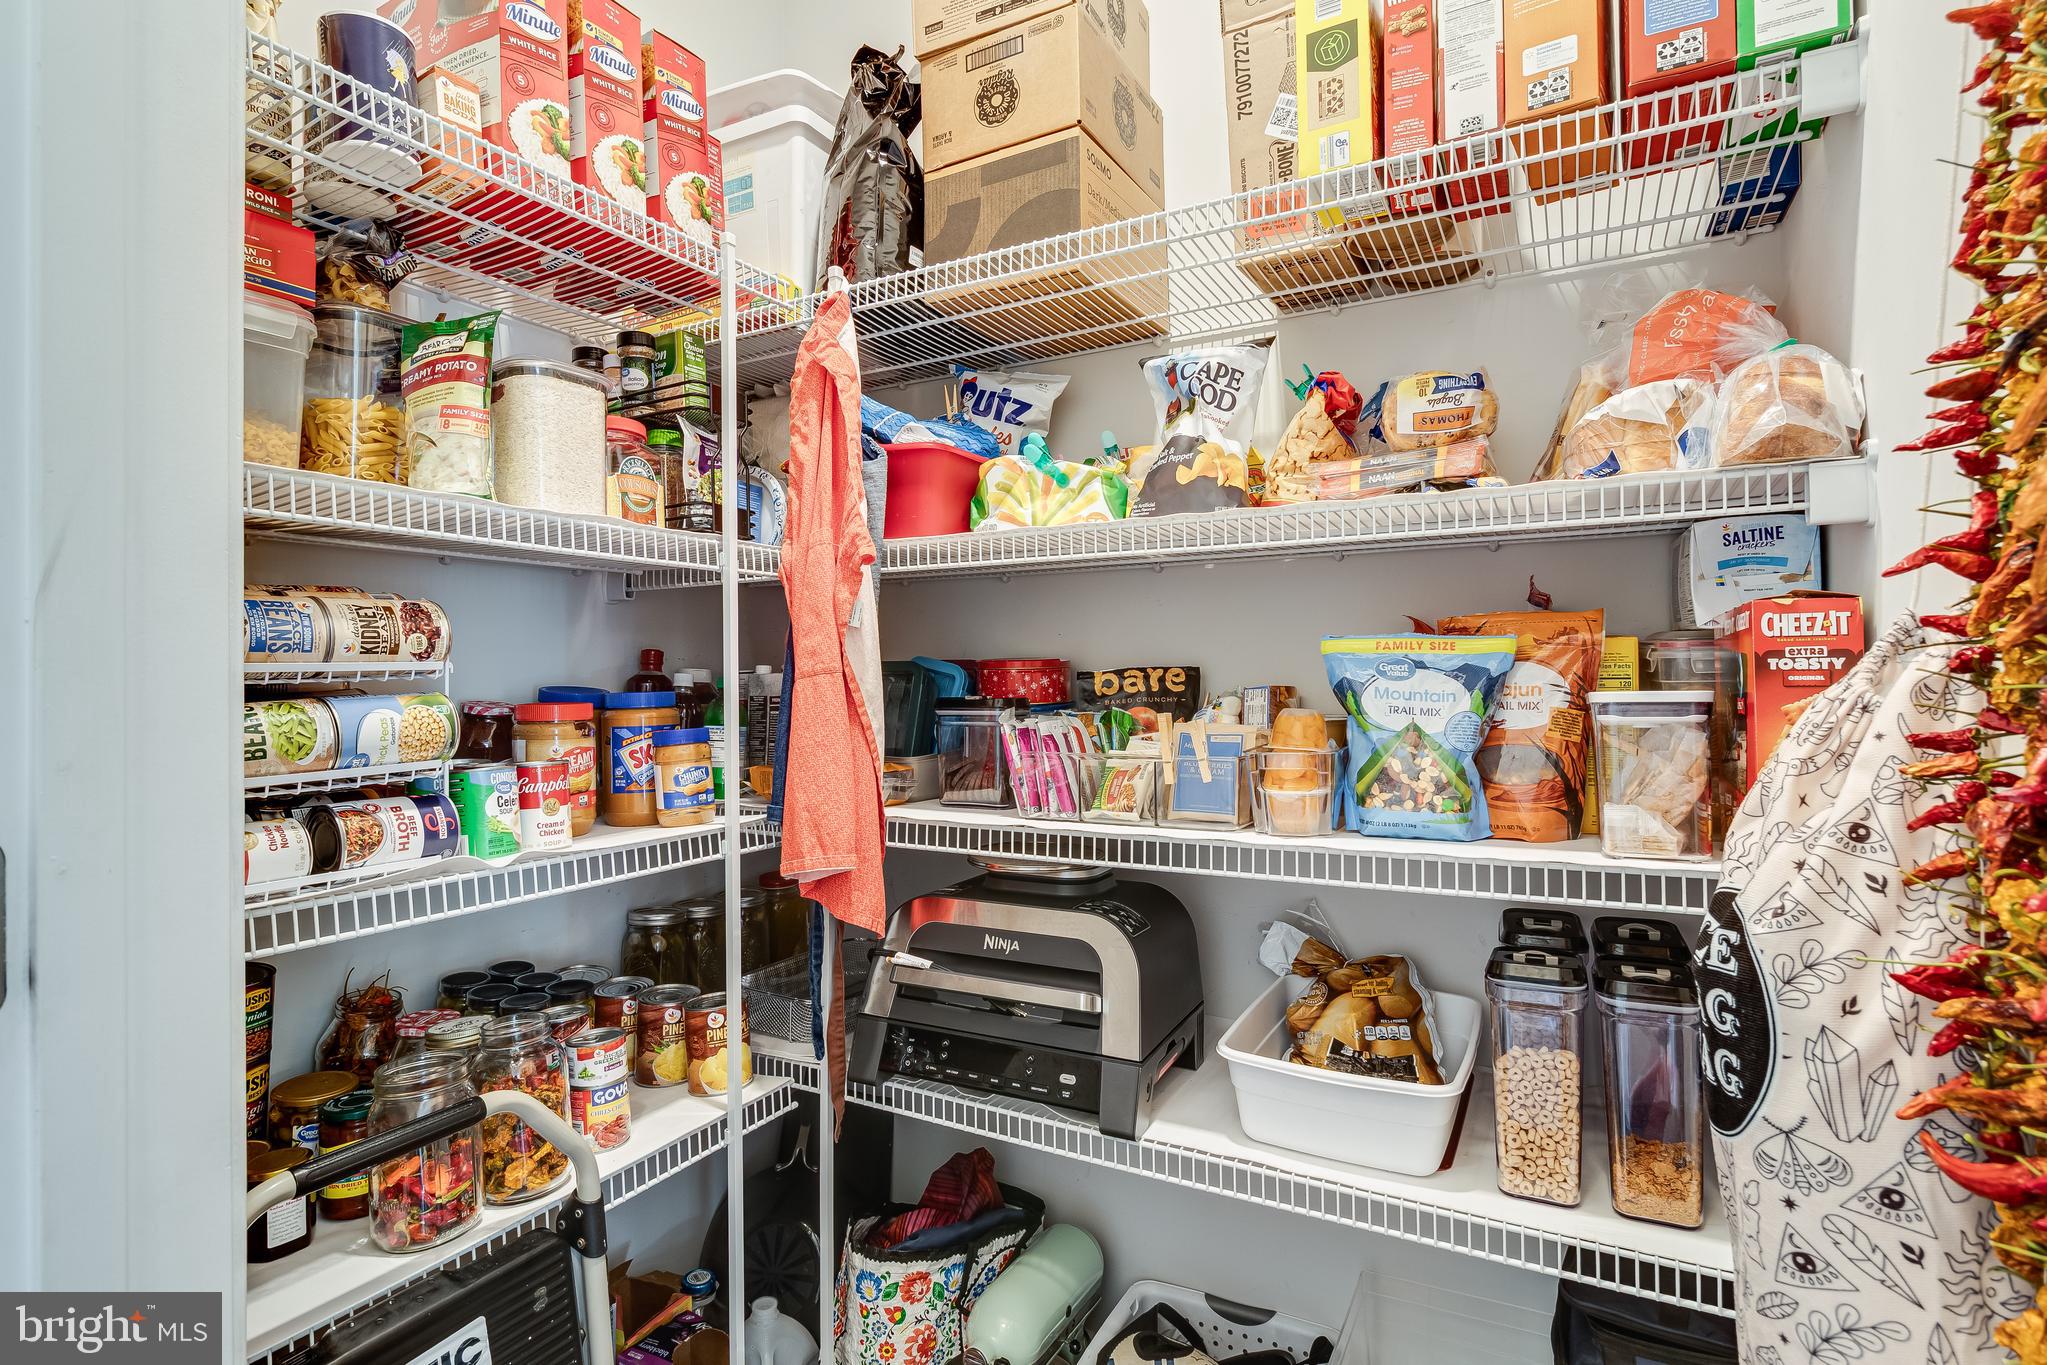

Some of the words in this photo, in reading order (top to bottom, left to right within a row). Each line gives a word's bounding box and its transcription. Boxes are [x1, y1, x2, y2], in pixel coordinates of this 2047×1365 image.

[506, 3, 562, 39] Minute
[508, 35, 537, 54] WHITE
[538, 46, 558, 63] RICE
[590, 46, 637, 79] Minute
[517, 74, 527, 87] 5
[978, 68, 1015, 88] Regular
[1233, 28, 1252, 121] 7910077272
[591, 75, 617, 93] WHITE
[617, 86, 634, 101] RICE
[443, 94, 477, 117] BAKING
[443, 104, 477, 124] SODA
[661, 90, 705, 118] Minute
[599, 111, 607, 123] 5
[663, 118, 688, 134] WHITE
[688, 126, 702, 140] RICE
[669, 150, 678, 163] 5
[683, 341, 704, 354] Onion
[434, 359, 478, 374] POTATO
[1181, 359, 1245, 392] CAPE
[1188, 376, 1237, 414] COD
[1425, 392, 1465, 408] Bagels
[442, 407, 470, 417] FAMILY
[442, 418, 451, 430] 8
[1168, 452, 1194, 464] Pepper
[1369, 454, 1397, 466] NAAN
[1368, 472, 1396, 484] NAAN
[1722, 525, 1785, 547] SALTINE
[1737, 539, 1776, 551] crackers
[260, 601, 290, 653] BEANS
[285, 601, 302, 653] BLACK
[301, 613, 312, 627] LOW
[348, 616, 360, 638] dark
[352, 604, 381, 655] KIDNEY
[373, 605, 389, 655] BEANS
[302, 627, 313, 651] SODIUM
[1375, 640, 1425, 651] FAMILY
[1428, 641, 1457, 651] SIZE
[1379, 662, 1409, 673] Great
[1386, 669, 1409, 677] Value
[1094, 667, 1187, 697] bare
[1502, 682, 1543, 699] ajun
[1104, 697, 1135, 706] BAKED
[1135, 695, 1179, 705] CRUNCHY
[1373, 686, 1457, 704] Mountain
[1388, 704, 1416, 716] TRAIL
[1419, 706, 1442, 717] MIX
[1517, 701, 1541, 712] MIX
[379, 718, 388, 743] Peas
[678, 767, 707, 782] CHUNKY
[499, 807, 513, 815] SOUP
[389, 805, 410, 852] BROTH
[406, 815, 418, 837] BEEF
[435, 807, 447, 838] SWANSON
[536, 821, 559, 830] Cream
[539, 828, 565, 837] Chicken
[263, 826, 278, 852] Chicken
[274, 824, 289, 849] Noodle
[983, 933, 1021, 955] NINJA
[246, 990, 271, 1008] USH'S
[593, 1080, 628, 1105] GOYA
[341, 1180, 363, 1189] DRIED
